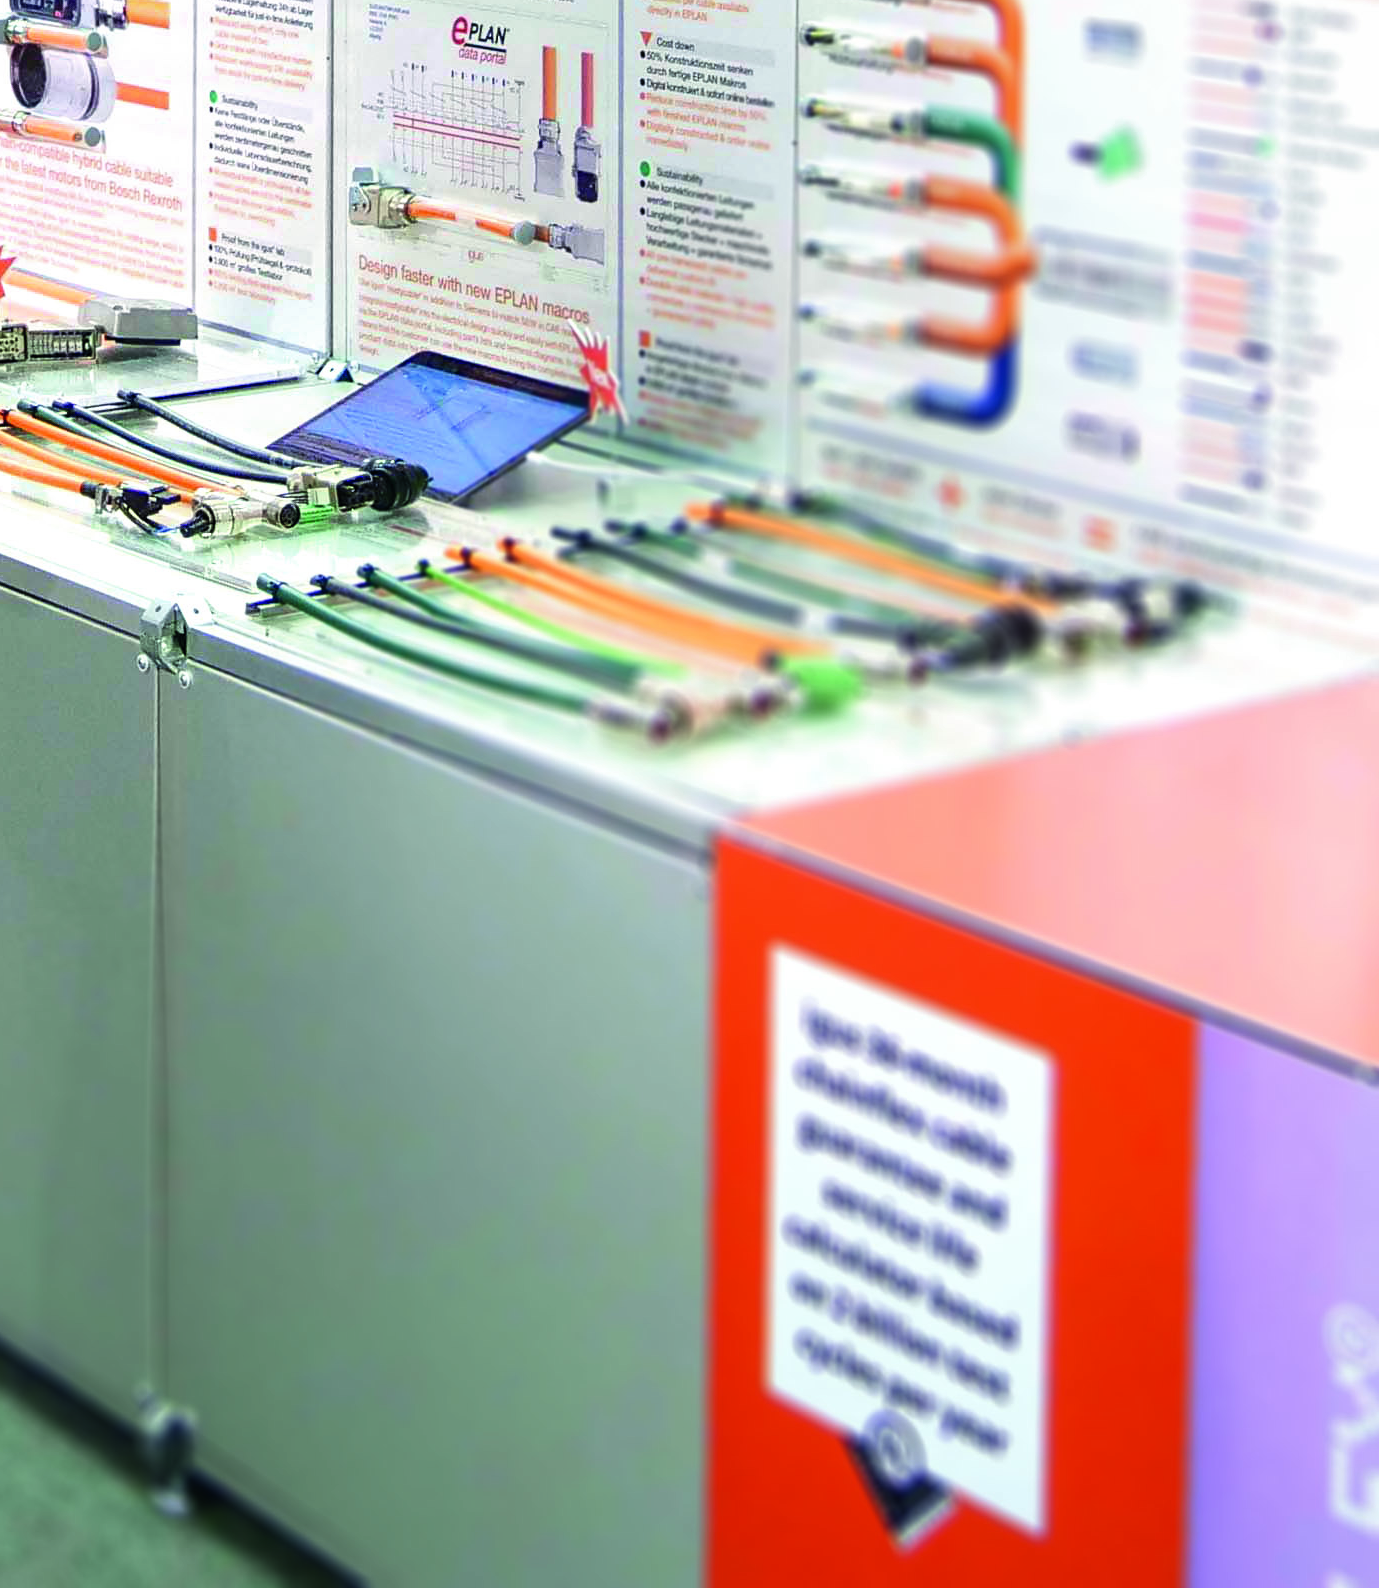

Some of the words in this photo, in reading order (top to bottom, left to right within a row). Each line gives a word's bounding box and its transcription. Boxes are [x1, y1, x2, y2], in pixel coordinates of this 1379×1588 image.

[458, 46, 477, 60] data
[479, 50, 507, 64] portal
[5, 155, 20, 170] the
[21, 158, 46, 176] latest
[49, 167, 82, 187] motors
[84, 174, 107, 192] from
[109, 181, 140, 202] Bosch
[143, 188, 182, 212] Rexroth
[72, 150, 102, 171] hybrid
[105, 159, 132, 177] cable
[134, 165, 173, 188] suitable
[359, 254, 397, 281] Design
[401, 264, 434, 288] faster
[438, 275, 463, 294] with
[466, 285, 491, 301] new
[495, 287, 539, 311] EPLAN
[543, 299, 590, 324] macros
